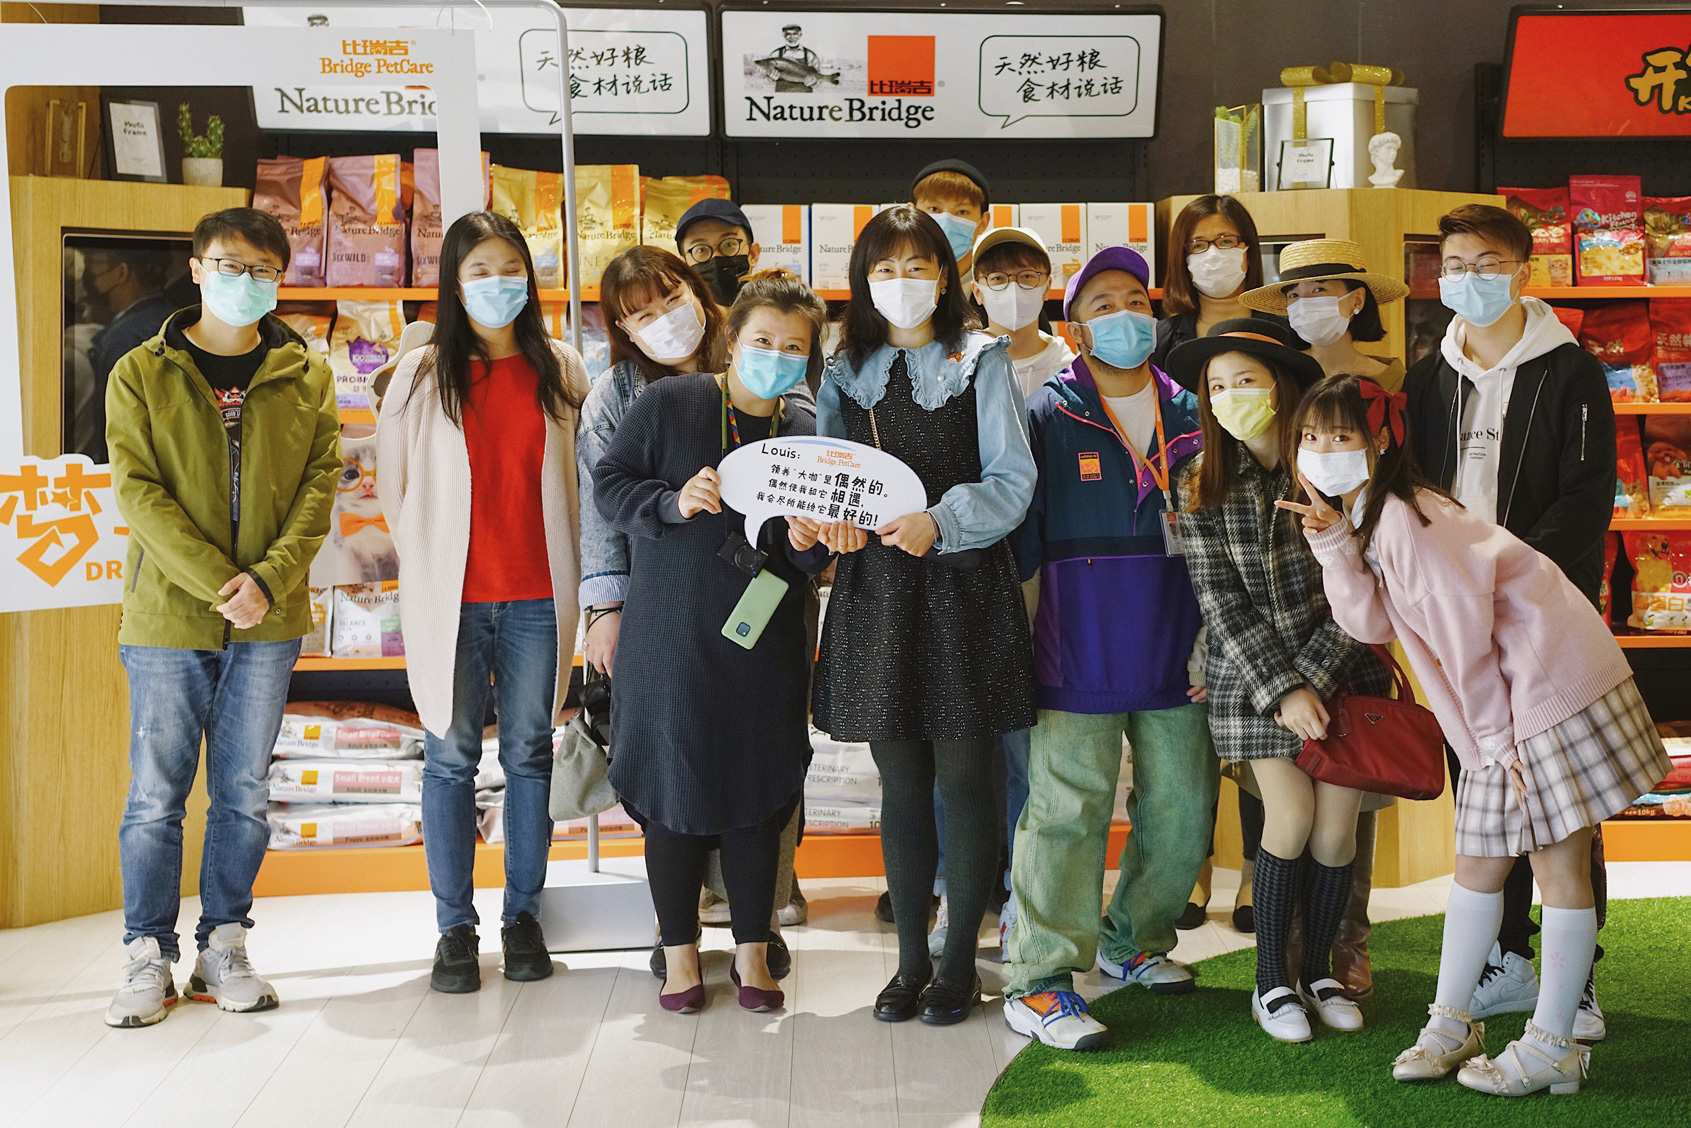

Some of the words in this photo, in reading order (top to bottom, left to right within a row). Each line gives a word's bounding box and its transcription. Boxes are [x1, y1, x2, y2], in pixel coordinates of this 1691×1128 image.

[342, 39, 409, 56] 比瑞吉
[319, 57, 372, 78] Bridge
[375, 58, 434, 74] PetCare
[994, 48, 1107, 76] 天然好粮
[1628, 45, 1691, 111] 开
[870, 80, 932, 94] 比瑞吉
[1016, 76, 1124, 103] 食材说话
[761, 443, 801, 459] Louis:
[817, 456, 837, 466] Bridge
[335, 774, 356, 783] Small
[358, 774, 380, 783] Breed
